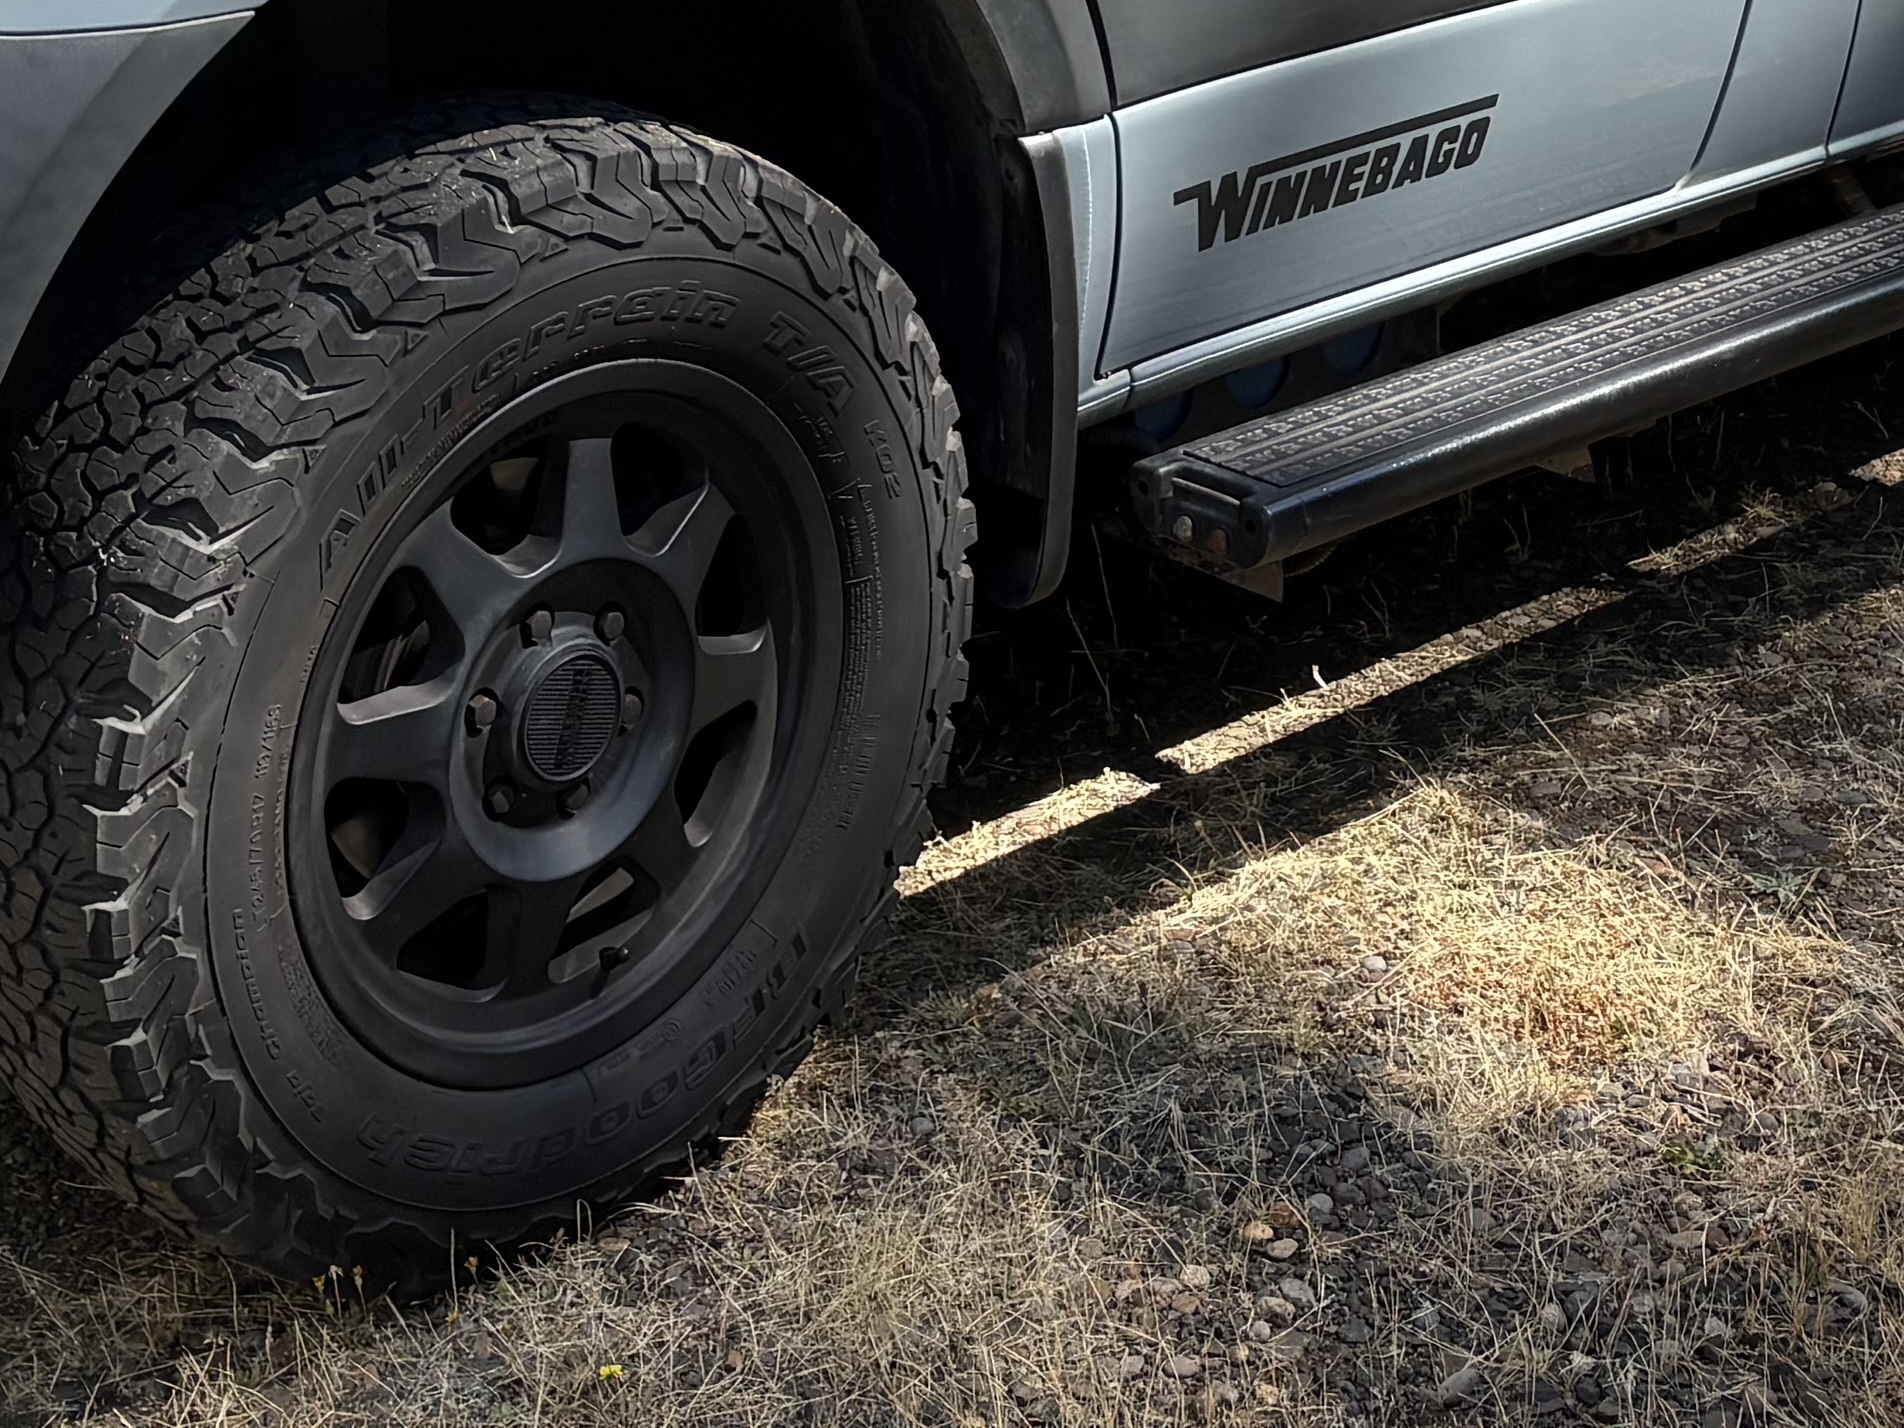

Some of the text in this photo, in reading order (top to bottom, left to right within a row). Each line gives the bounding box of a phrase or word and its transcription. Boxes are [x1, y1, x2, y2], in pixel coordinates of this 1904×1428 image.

[1173, 93, 1500, 252] WINNEBAGO
[318, 279, 744, 582] All-Terrain
[761, 310, 862, 418] T/A
